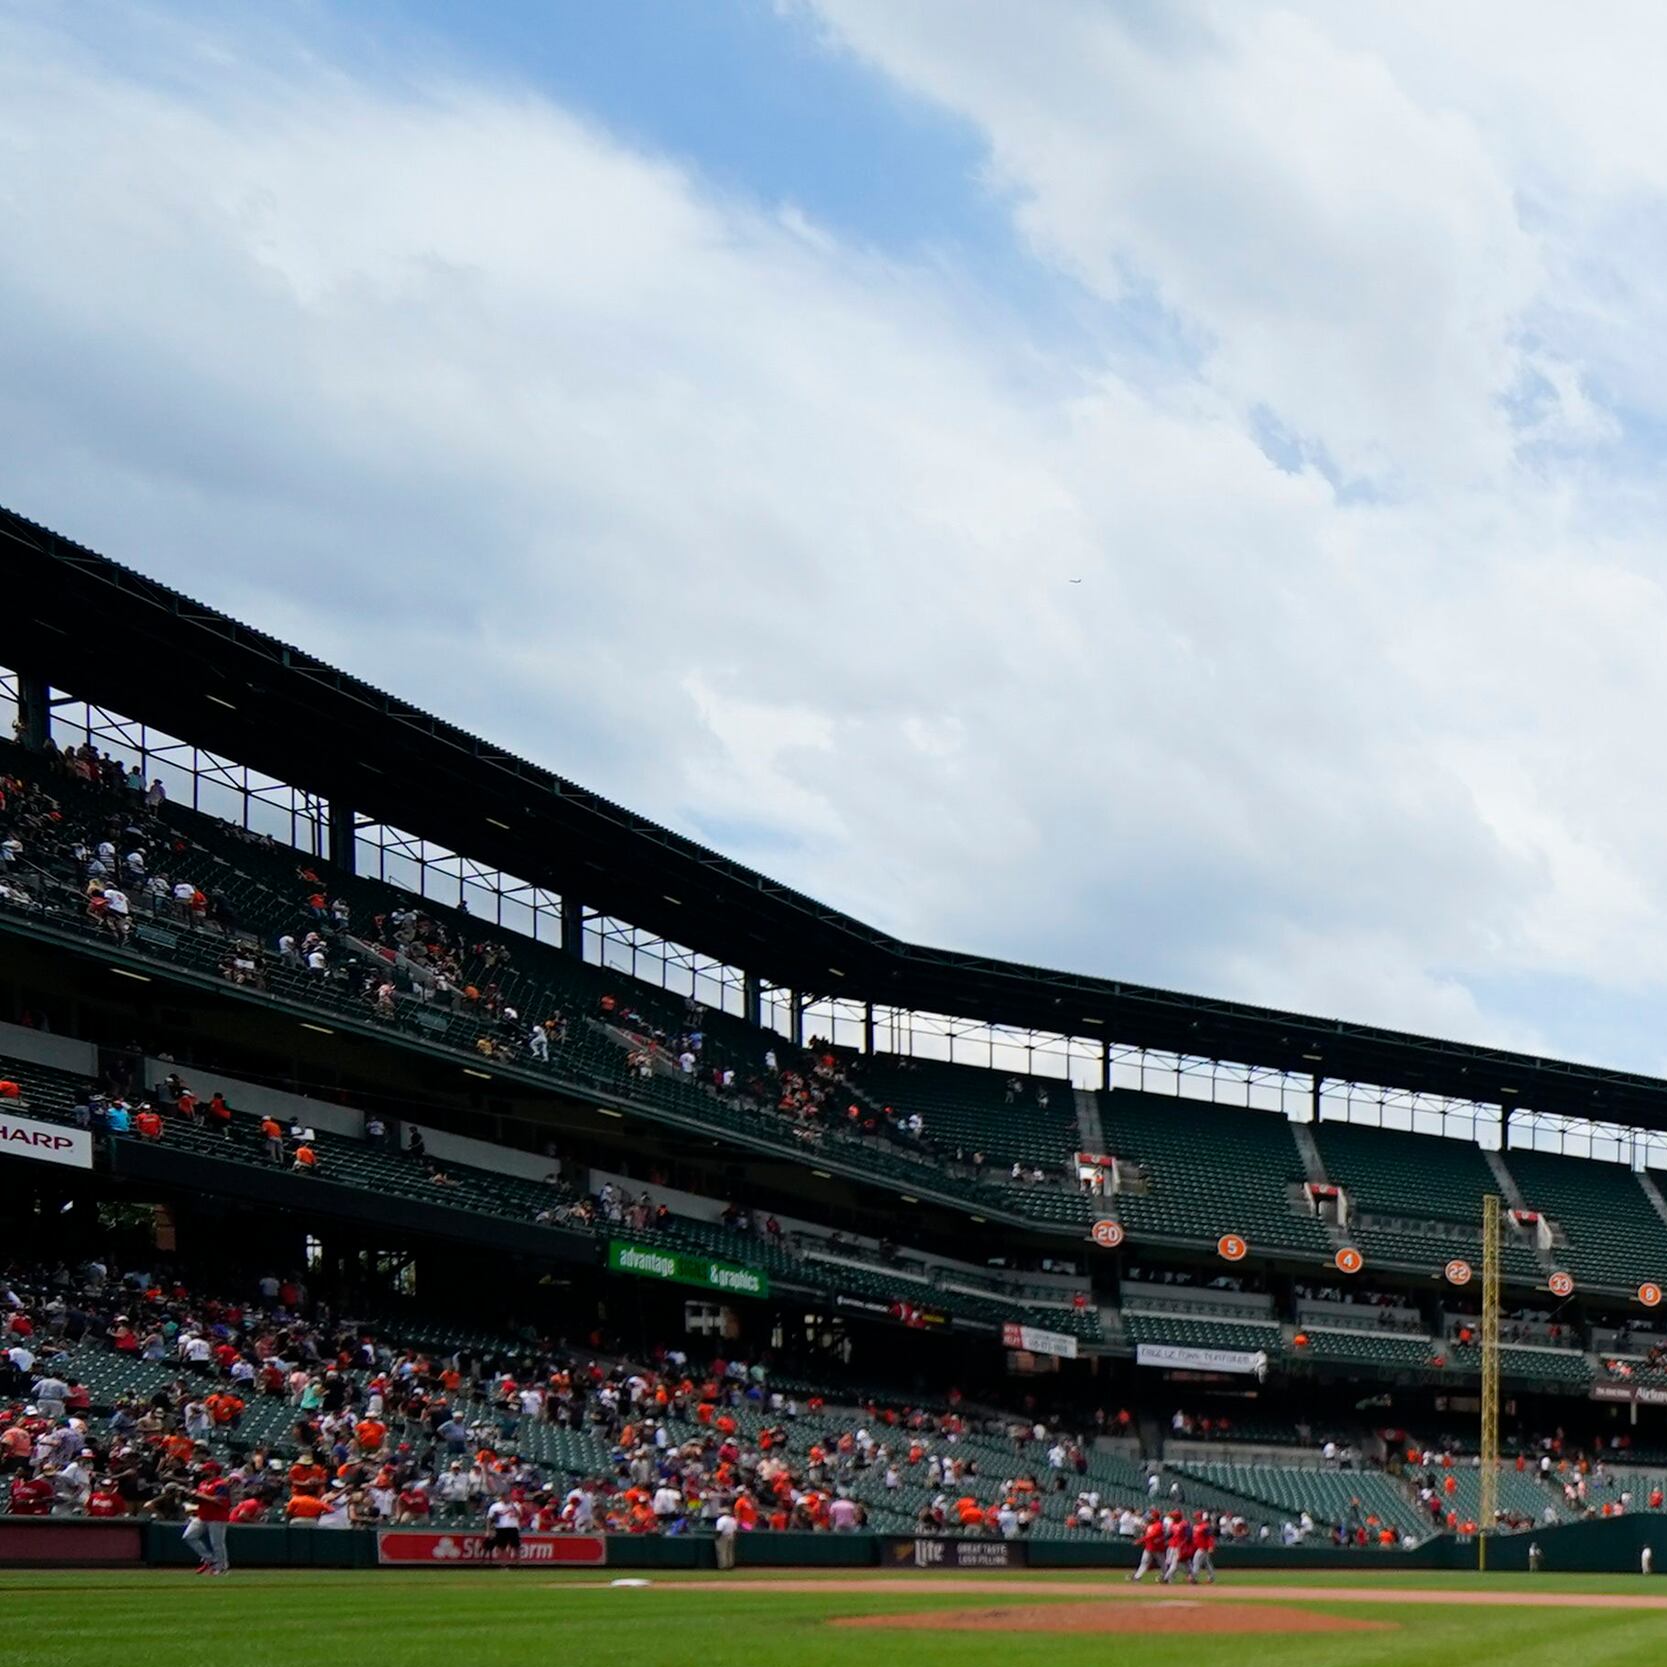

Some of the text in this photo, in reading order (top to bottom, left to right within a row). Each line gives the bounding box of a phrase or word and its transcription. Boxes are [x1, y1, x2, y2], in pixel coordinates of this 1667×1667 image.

[1097, 1226, 1118, 1241] 20
[1227, 1240, 1237, 1255] 5
[1342, 1253, 1354, 1267] 4
[619, 1247, 675, 1277] advantage
[709, 1264, 718, 1283] &
[719, 1269, 760, 1292] graphics
[1448, 1265, 1467, 1280] 22
[1552, 1278, 1568, 1290] 33
